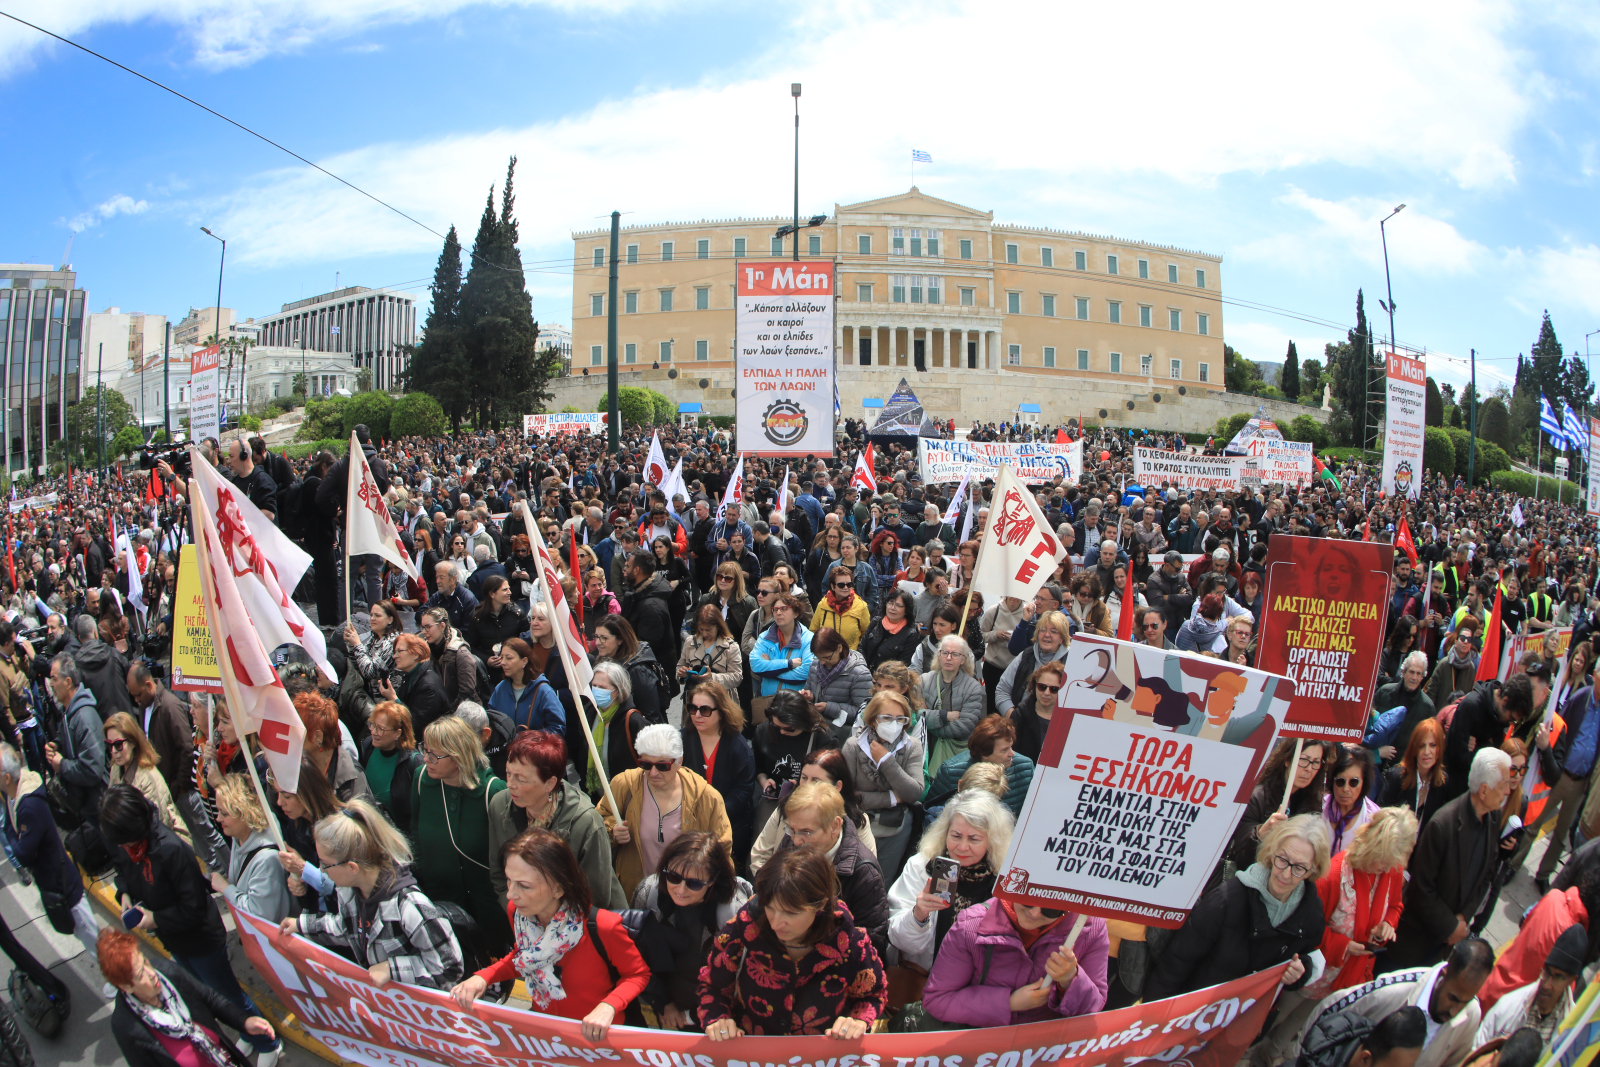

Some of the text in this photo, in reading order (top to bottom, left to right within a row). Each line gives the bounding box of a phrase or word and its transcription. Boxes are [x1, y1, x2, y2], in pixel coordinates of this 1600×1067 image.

[771, 265, 829, 290] Μάη
[785, 302, 826, 314] αλλάζουν
[767, 317, 804, 329] οι καιροί
[757, 331, 813, 341] και οι ελπίδες
[760, 345, 783, 355] λαών
[743, 368, 827, 377] ΕΛΠΙΔΑ Η ΠΑΛΗ
[1401, 359, 1423, 382] Μάη
[754, 381, 816, 391] ΤΩΝ ΛΑΩΝ!
[1138, 449, 1147, 458] ΤΟ
[1149, 450, 1189, 461] ΚΕΦΑΛΑΙΟ
[1142, 462, 1151, 471] ΤΟ
[1153, 462, 1182, 473] ΚΡΑΤΟΣ
[1184, 465, 1231, 476] ΣΥΓΚΑΛΥΠΤΕΙ
[1274, 595, 1378, 620] ΛΑΣΤΙΧΟ ΔΟΥΛΕΙΑ
[184, 616, 195, 626] ΤΗΣ
[1299, 614, 1351, 635] ΤΣΑΚΙΖΕΙ
[187, 627, 206, 637] ΚΑΜΙΑ
[192, 638, 201, 646] ΤΗΣ
[179, 646, 189, 655] ΣΤΟ
[190, 646, 210, 656] ΚΡΑΤΟΣ
[1286, 630, 1357, 655] ΤΗ ΖΩΗ ΜΑΣ,
[194, 656, 217, 665] ΤΟΥ ΙΣΡΑ
[1289, 648, 1350, 668] ΟΡΓΑΝΩΣΗ
[1286, 663, 1347, 685] ΚΙ ΑΓΩΝΑΣ
[1338, 686, 1363, 702] ΜΑΣ
[1298, 723, 1324, 734] ΓΥΝΑΙΚΩΝ
[1324, 726, 1348, 737] ΕΛΛΑΔΑΣ
[1348, 729, 1361, 739] (ΟΓΕ)
[1127, 733, 1193, 772] ΤΩΡΑ
[1069, 753, 1227, 808] ΞΕΣΗΚΩΜΟΣ
[1078, 784, 1200, 823] ΕΝΑΝΤΙΑ ΣΤΗΝ
[1073, 803, 1192, 840] ΕΜΠΛΟΚΗ ΤΗΣ
[1059, 819, 1186, 858] ΧΩΡΑΣ ΜΑΣ ΣΤΑ
[1044, 837, 1186, 876] ΝΑΤΟΪΚΑ ΣΦΑΓΕΙΑ
[1056, 856, 1165, 889] ΤΟΥ ΠΟΛΕΜΟΥ
[1028, 887, 1185, 922] ΟΜΟΣΠΟΝΔΙΑ ΓΥΝΑΙΚΩΝ ΕΛΛΑΔΑΣ (ΟΓΕ)
[292, 995, 374, 1040] ΜΑΗ
[493, 1020, 620, 1063] Τιμάμε
[622, 1048, 713, 1067] τους
